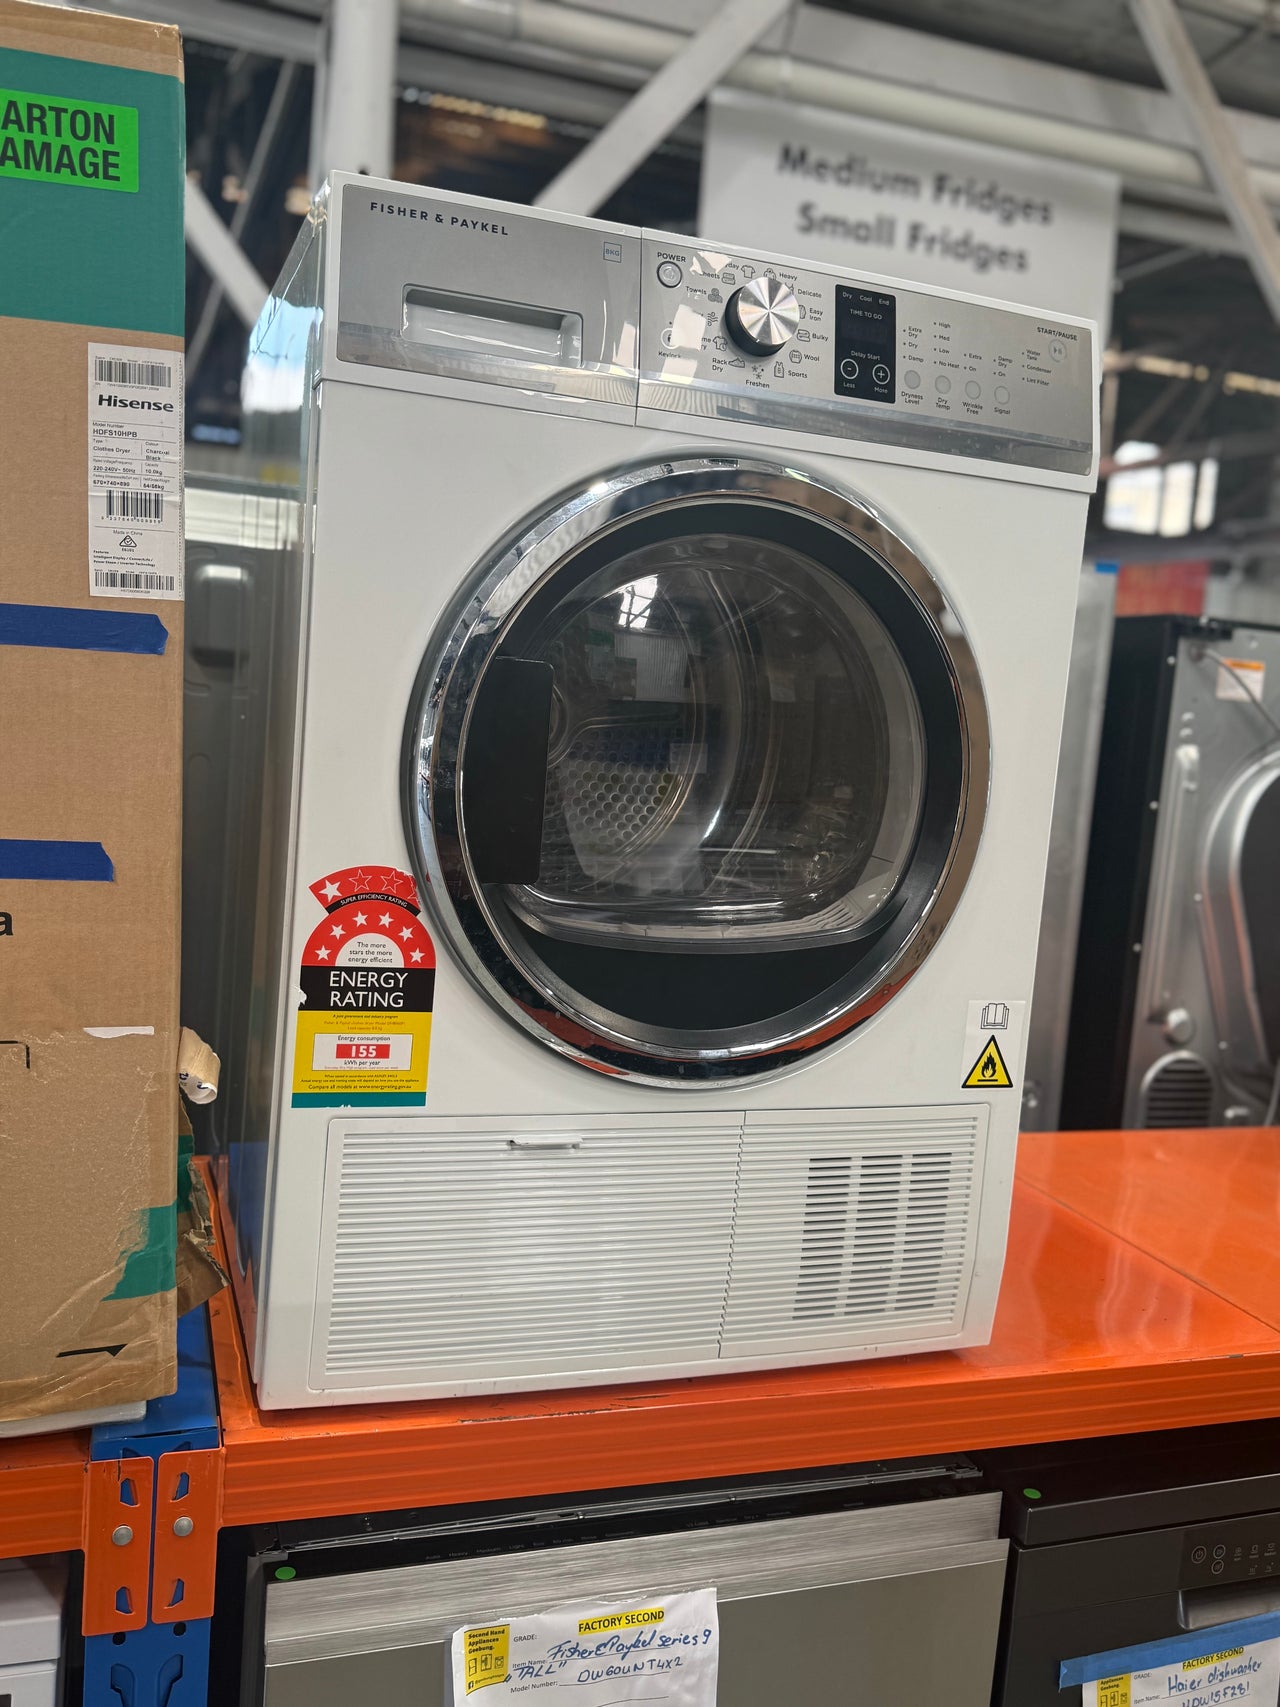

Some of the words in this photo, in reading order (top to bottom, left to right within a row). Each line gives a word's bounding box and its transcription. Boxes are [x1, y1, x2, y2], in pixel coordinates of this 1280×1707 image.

[1, 100, 115, 145] ARTON
[0, 137, 121, 182] AMAGE
[777, 142, 921, 198] Medium
[932, 173, 1053, 226] Fridges
[371, 202, 429, 221] FISHER
[435, 214, 444, 224] &
[451, 216, 509, 236] PAYKEL
[797, 201, 896, 248] Small
[907, 221, 1030, 274] Fridges
[605, 248, 620, 257] 8KG
[657, 252, 686, 263] POWER
[779, 272, 798, 282] Heavy
[686, 286, 707, 295] Towels
[798, 289, 823, 299] Delicate
[878, 298, 890, 306] End
[809, 308, 824, 316] Easy
[850, 309, 863, 317] TIME
[812, 333, 829, 342] Bulky
[1037, 327, 1078, 341] START/PAUSE
[804, 354, 820, 362] Wool
[851, 350, 866, 359] Delay
[867, 353, 880, 361] Start
[908, 355, 924, 363] Damp
[712, 358, 728, 366] Rack
[788, 370, 808, 379] Sports
[745, 380, 770, 389] Freshen
[901, 391, 924, 401] Dryness
[938, 397, 948, 405] Dry
[98, 394, 174, 413] Hisense
[936, 403, 950, 411] Temp
[962, 402, 983, 410] Wrinkle
[994, 407, 1011, 415] Signal
[93, 428, 137, 438] HDFS10HPB
[340, 896, 357, 906] SUPER
[388, 896, 408, 908] RATING
[329, 971, 409, 988] ENERGY
[330, 991, 404, 1008] RATING
[351, 1046, 377, 1057] 155
[578, 1616, 622, 1633] FACTORY
[624, 1610, 664, 1625] SECOND
[468, 1631, 489, 1639] Second
[513, 1634, 537, 1642] GRADE:
[468, 1637, 499, 1647] Appliances
[547, 1640, 596, 1660] Fisher
[658, 1633, 698, 1647] series
[1182, 1656, 1215, 1670] FACTORY
[1215, 1647, 1244, 1661] SECOND
[1101, 1677, 1124, 1685] Appliances
[1168, 1674, 1202, 1696] Haier
[1208, 1656, 1262, 1683] dishwasher
[510, 1685, 530, 1693] Model
[531, 1681, 558, 1689] Number:
